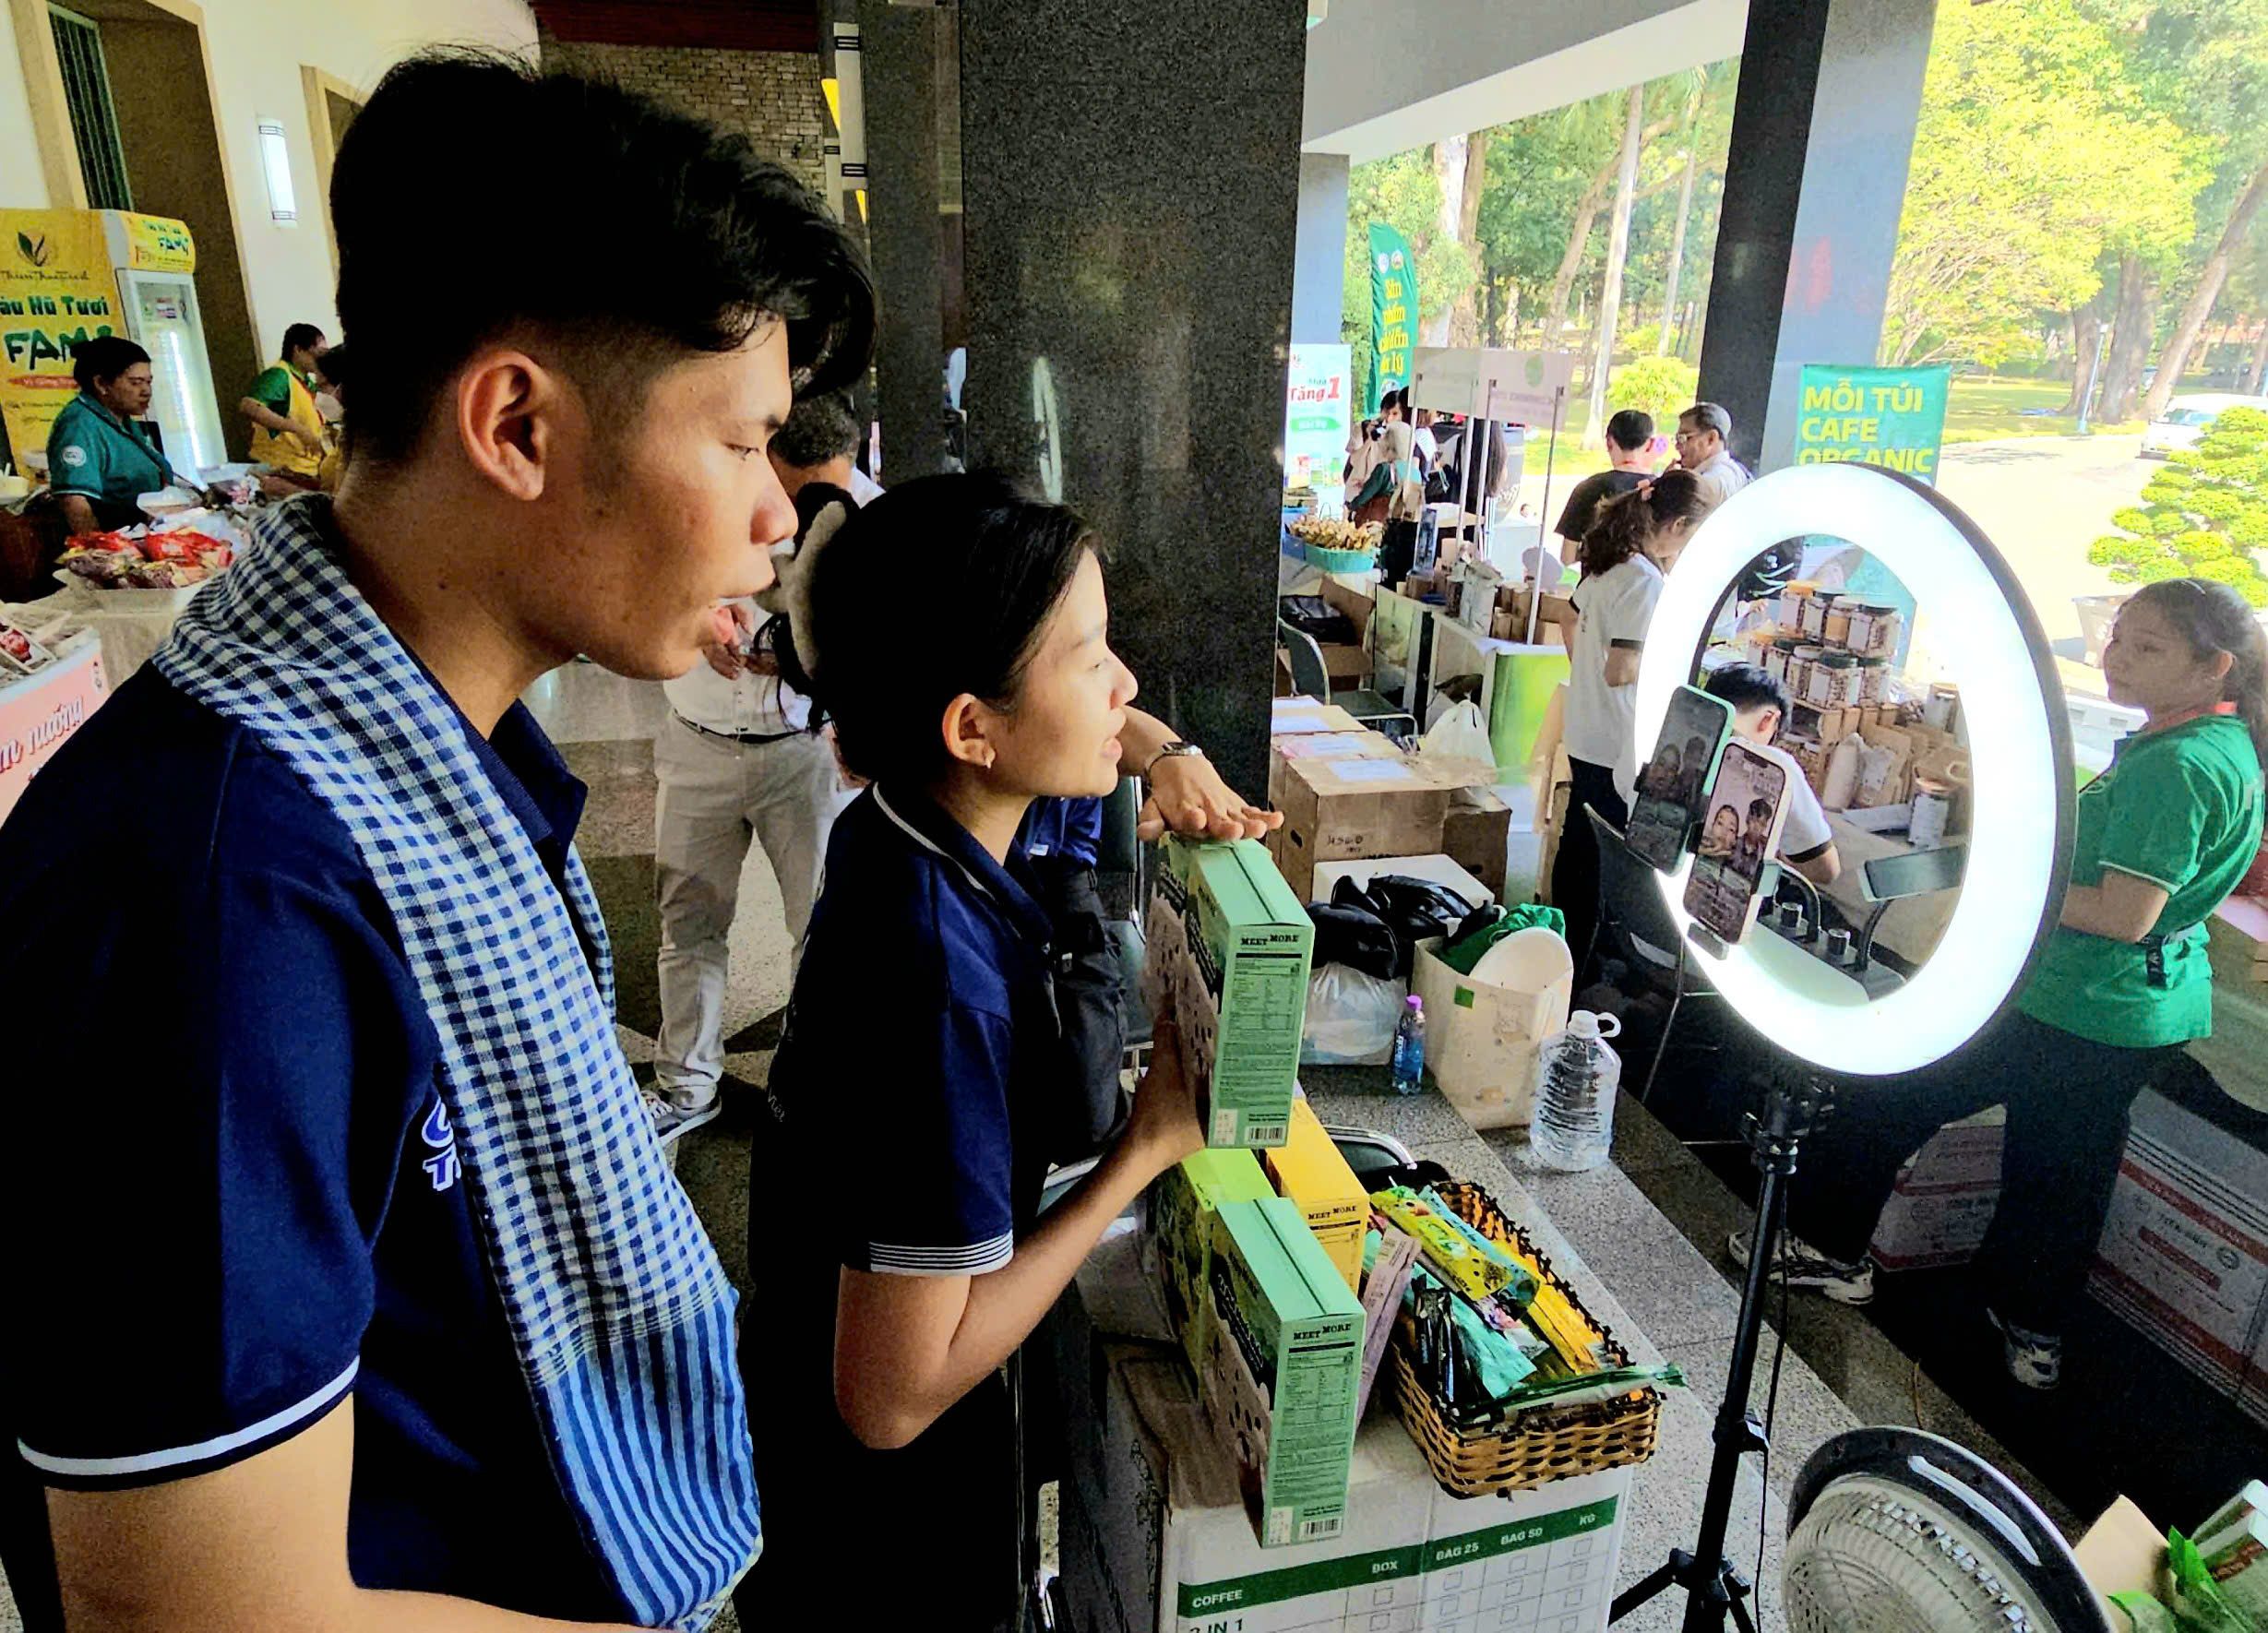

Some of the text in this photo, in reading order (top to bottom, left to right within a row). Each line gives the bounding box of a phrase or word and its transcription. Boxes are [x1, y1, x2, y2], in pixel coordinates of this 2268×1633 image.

[1800, 415, 1881, 443] CAFE
[1240, 934, 1300, 946] MEET MORE
[1307, 1205, 1356, 1220] MEET MORE
[1293, 1323, 1352, 1341] MEET MORE
[1579, 1513, 1596, 1526] KG
[1500, 1526, 1544, 1546] BAG 50
[1435, 1541, 1480, 1562] BAG 25
[1371, 1559, 1399, 1574] BOX
[1191, 1589, 1243, 1608] COFFEE
